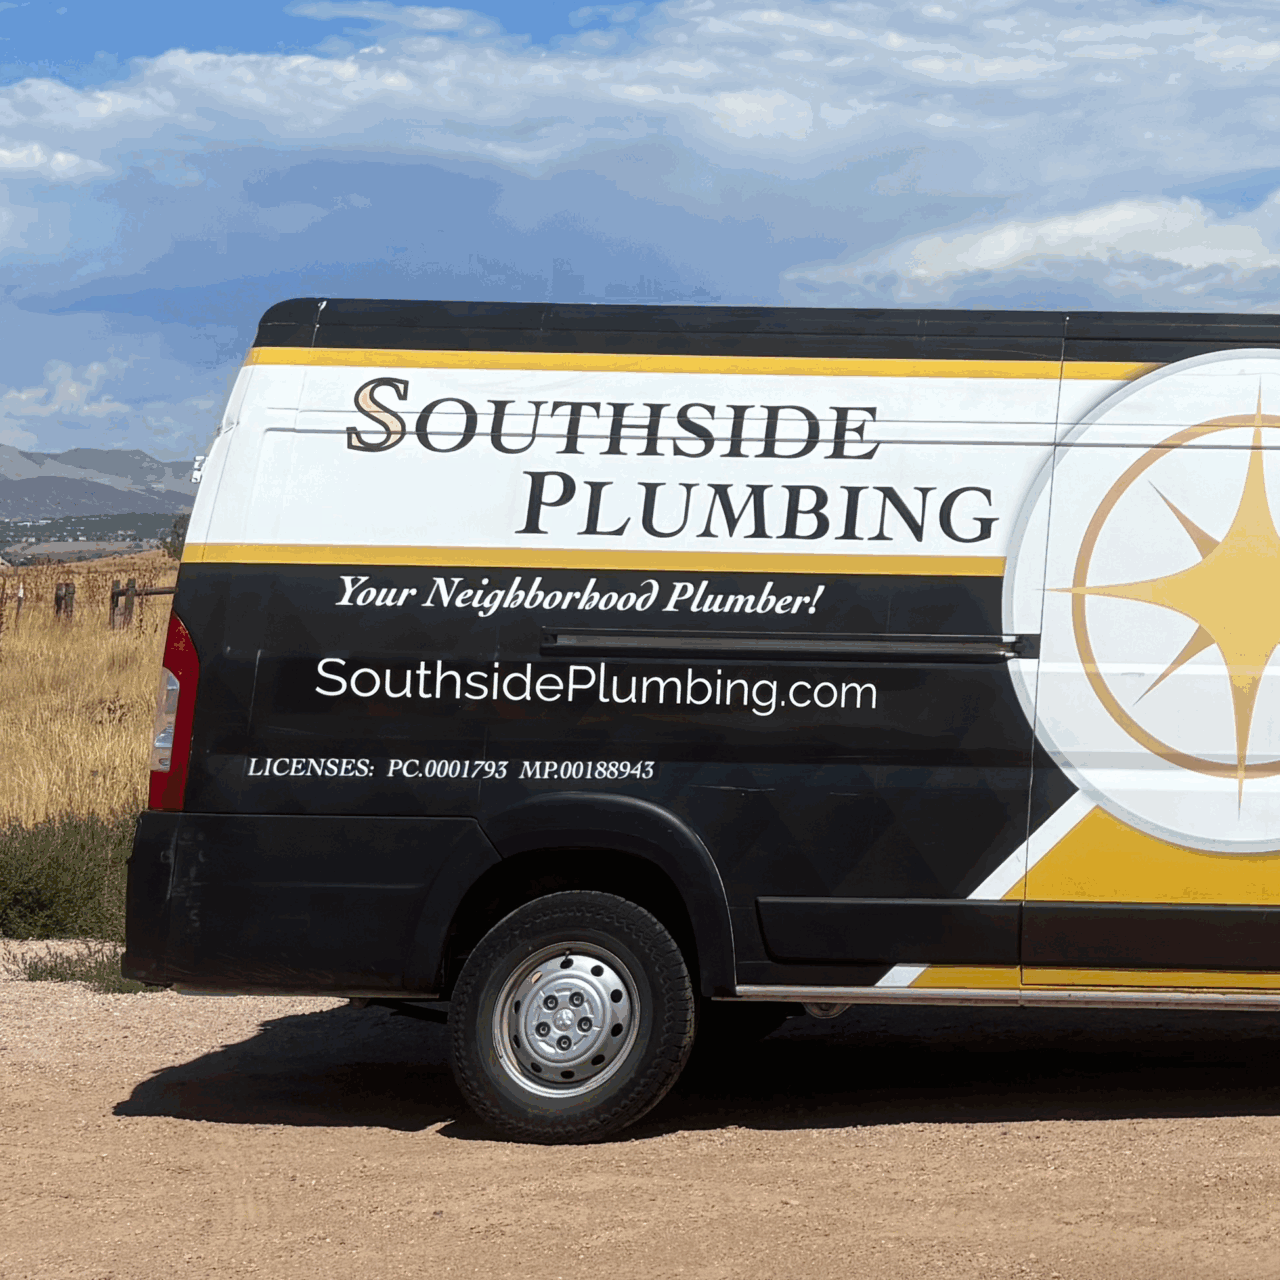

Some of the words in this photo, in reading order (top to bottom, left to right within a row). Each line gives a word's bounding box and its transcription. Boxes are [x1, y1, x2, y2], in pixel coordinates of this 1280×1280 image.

[346, 377, 880, 460] SOUTHSIDE
[515, 471, 999, 543] PLUMBING
[335, 575, 418, 607] Your
[421, 576, 660, 618] Neighborhood
[661, 579, 826, 615] Plumber!
[315, 657, 878, 717] SouthsidePlumbing.com
[247, 757, 375, 777] LICENSES:
[386, 758, 509, 779] PC.0001793
[518, 760, 655, 780] MP.00188943
